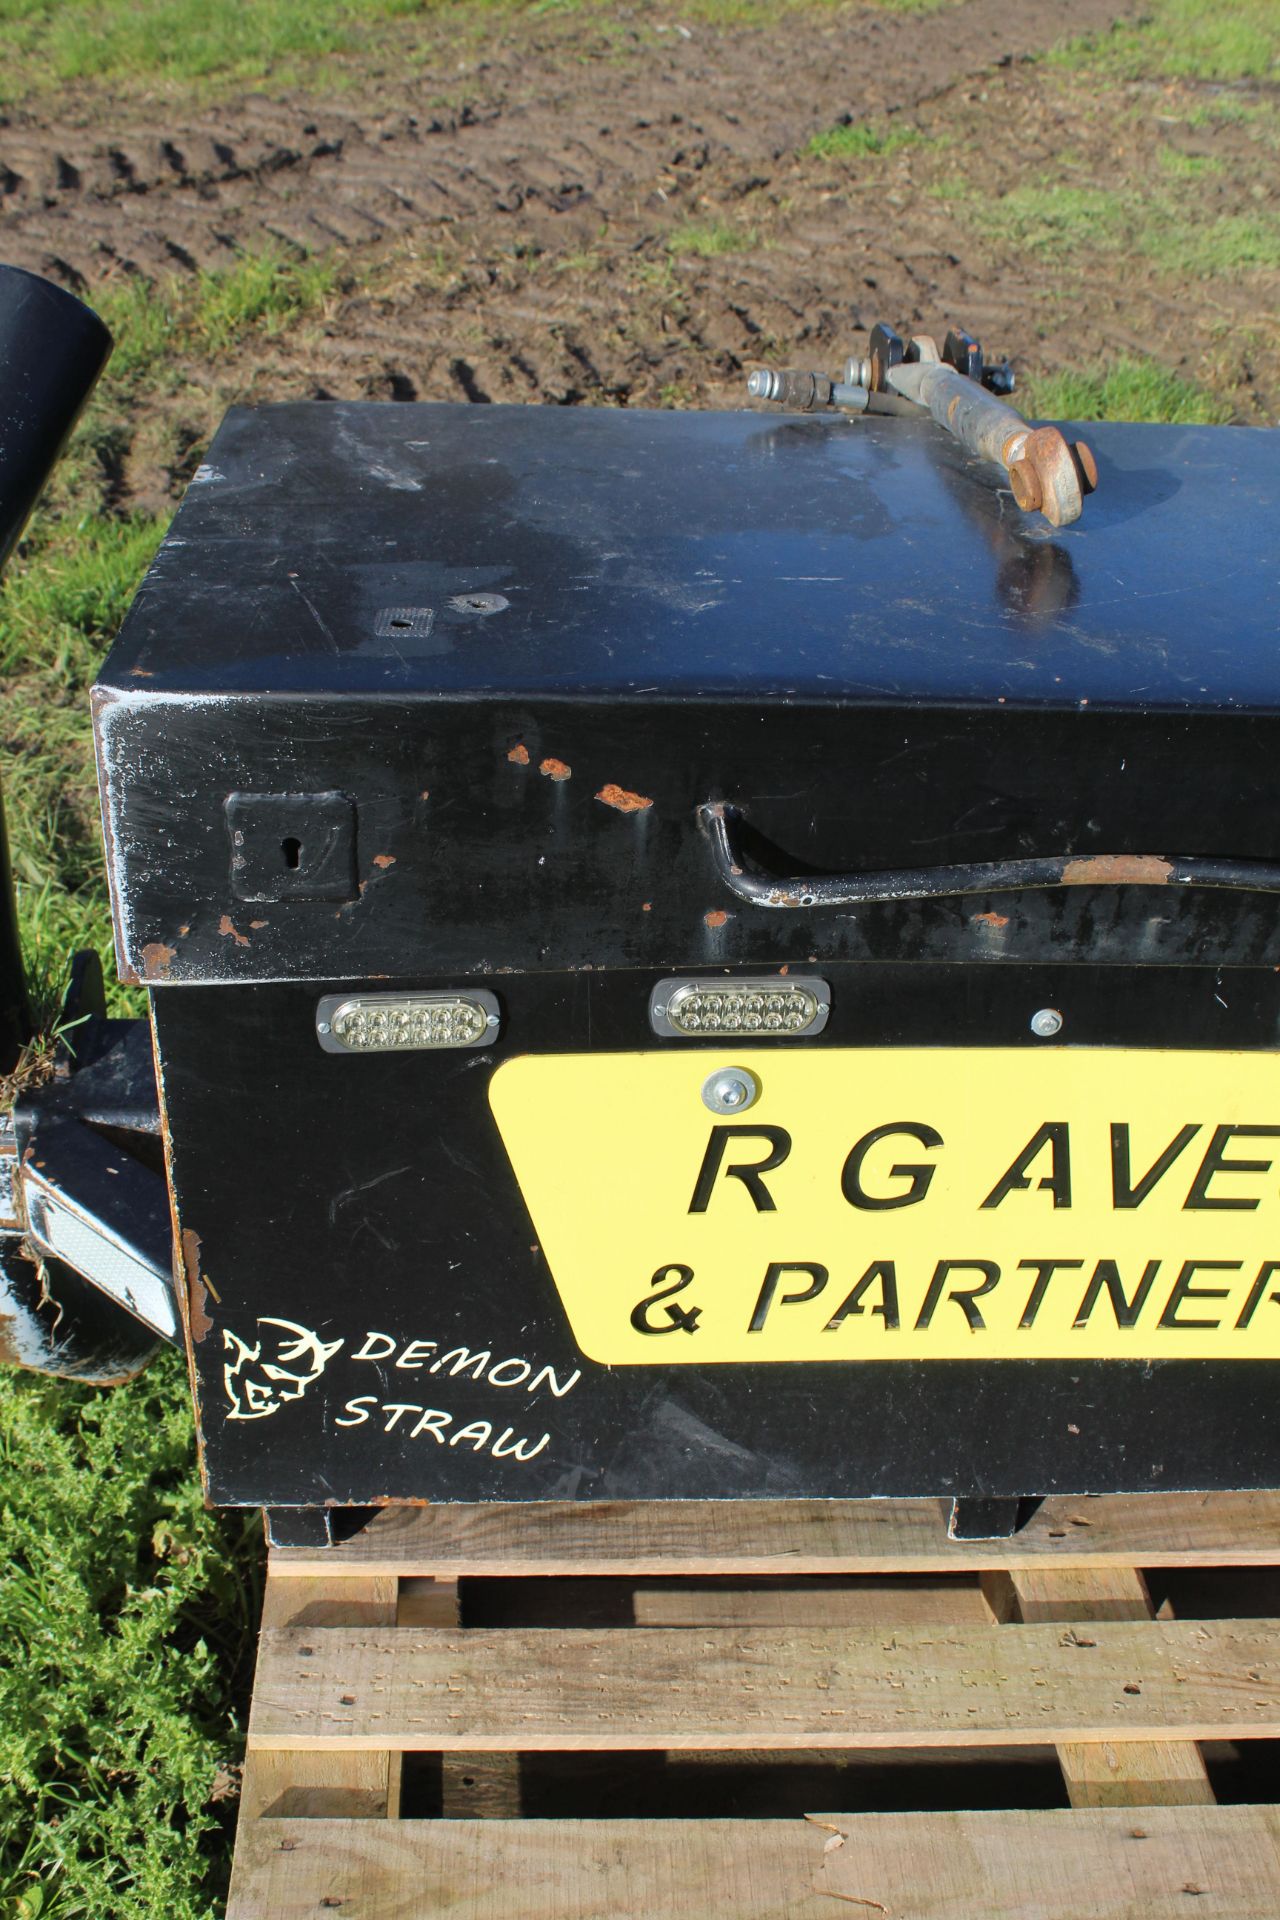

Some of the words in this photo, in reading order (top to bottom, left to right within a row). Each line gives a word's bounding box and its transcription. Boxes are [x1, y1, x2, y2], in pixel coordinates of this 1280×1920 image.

[687, 1124, 793, 1215] R
[840, 1121, 945, 1212] G
[979, 1121, 1280, 1211] AVE
[629, 1263, 704, 1337] &
[350, 1331, 582, 1397] DEMON
[334, 1395, 551, 1462] STRAW
